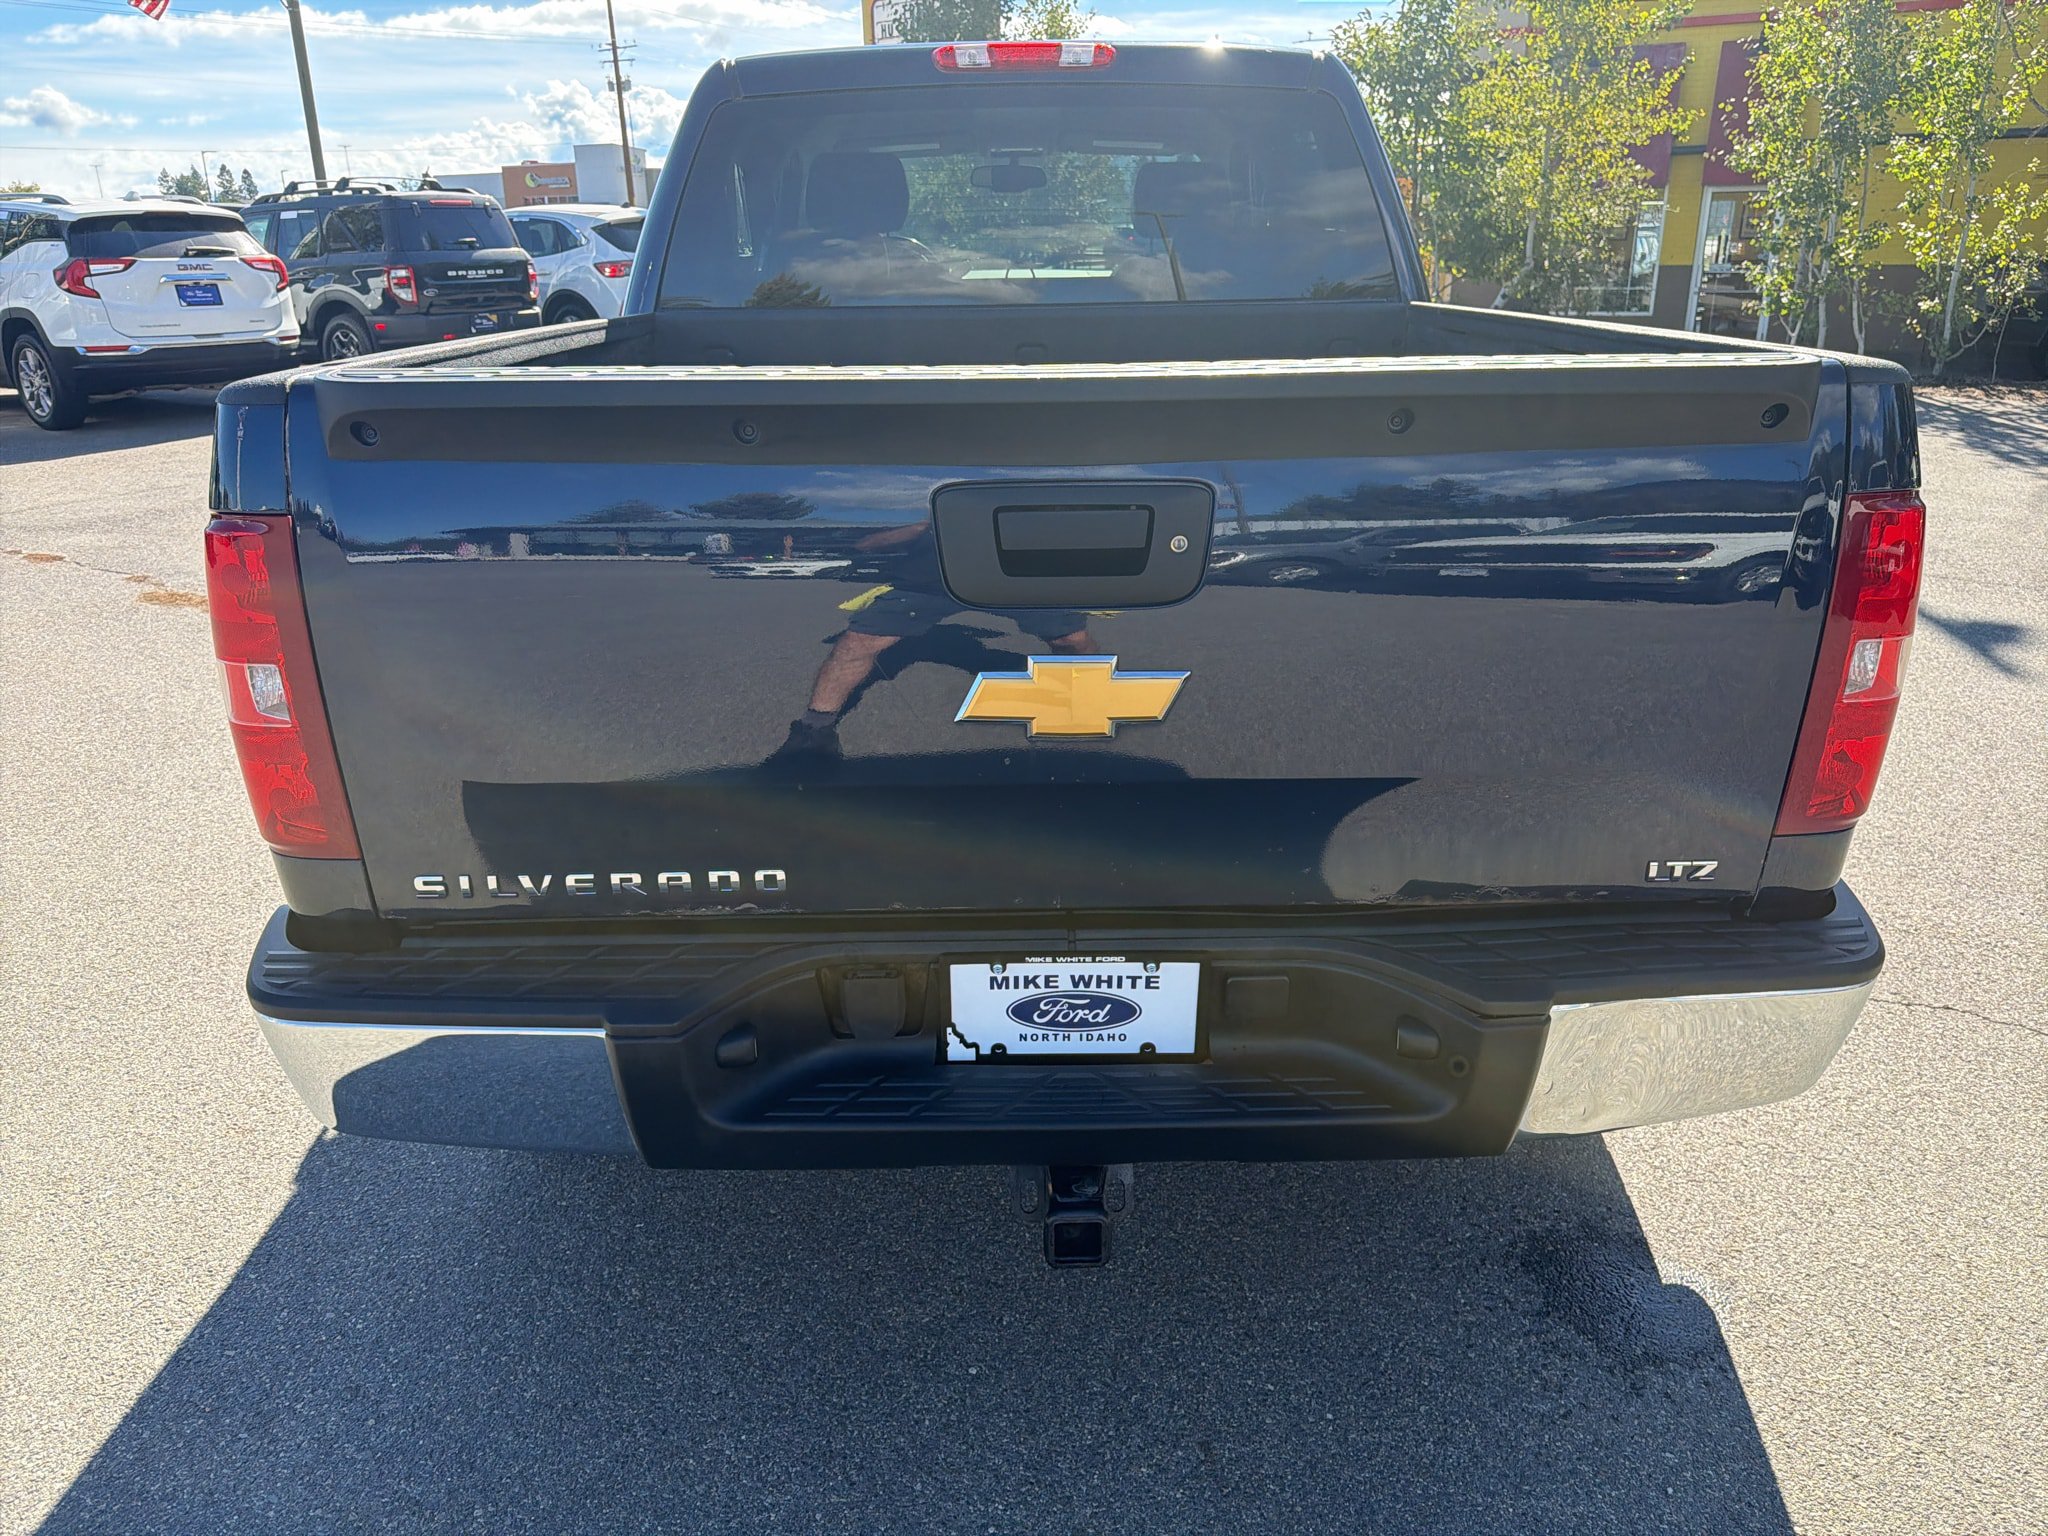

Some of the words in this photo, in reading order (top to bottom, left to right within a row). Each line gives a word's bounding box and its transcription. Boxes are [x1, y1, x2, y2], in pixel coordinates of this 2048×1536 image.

[176, 263, 214, 271] GMC
[447, 268, 504, 276] BRONCO
[1645, 860, 1719, 881] LTZ
[412, 869, 788, 898] SILVERADO
[989, 974, 1059, 990] MIKE
[1070, 974, 1161, 990] WHITE
[1032, 997, 1112, 1023] Ford
[1019, 1033, 1071, 1042] NORTH
[1079, 1033, 1127, 1042] IDAHO
